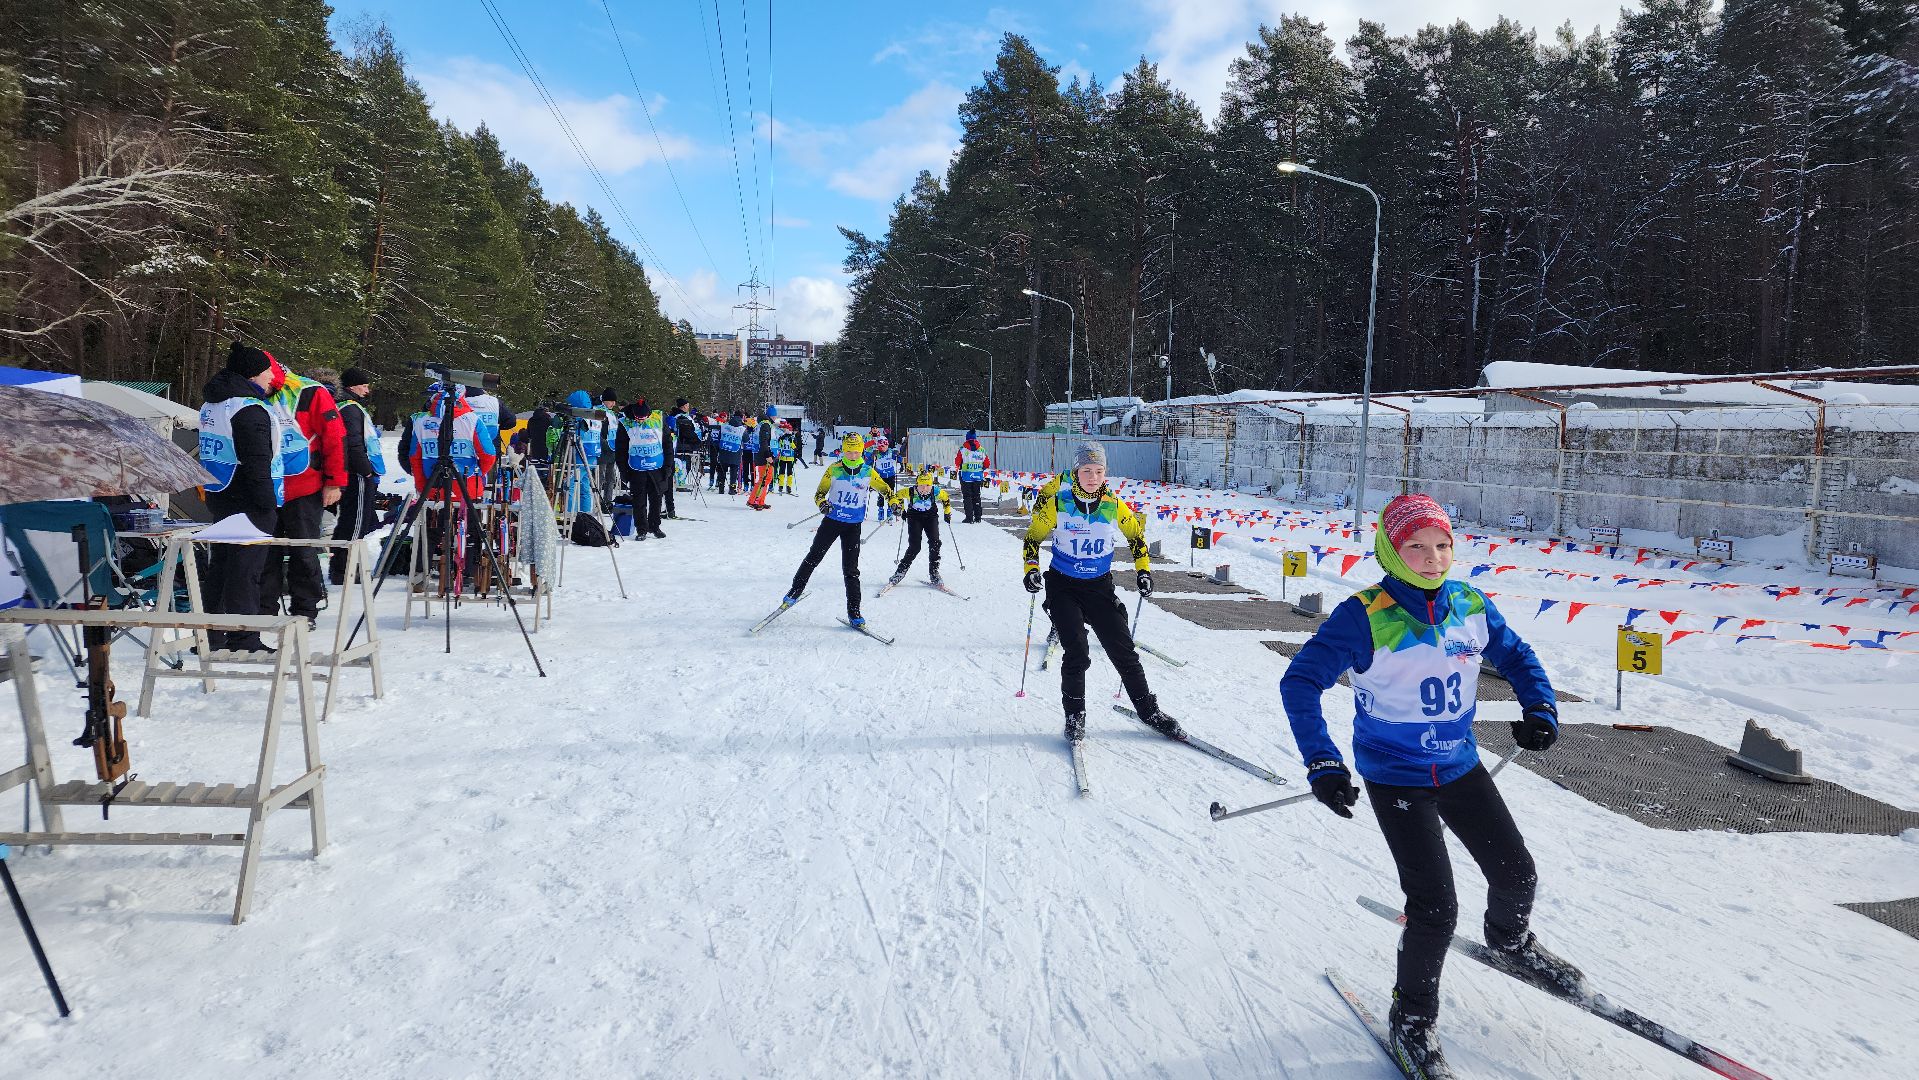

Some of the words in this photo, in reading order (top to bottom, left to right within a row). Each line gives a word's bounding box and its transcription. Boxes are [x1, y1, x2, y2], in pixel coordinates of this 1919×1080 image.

[422, 441, 467, 455] ТРЕР
[838, 490, 859, 506] 144
[1069, 538, 1105, 555] 140
[1196, 538, 1204, 548] 8
[1290, 562, 1299, 576] 7
[1632, 650, 1647, 671] 5
[1360, 692, 1367, 707] 3
[1420, 671, 1462, 717] 93
